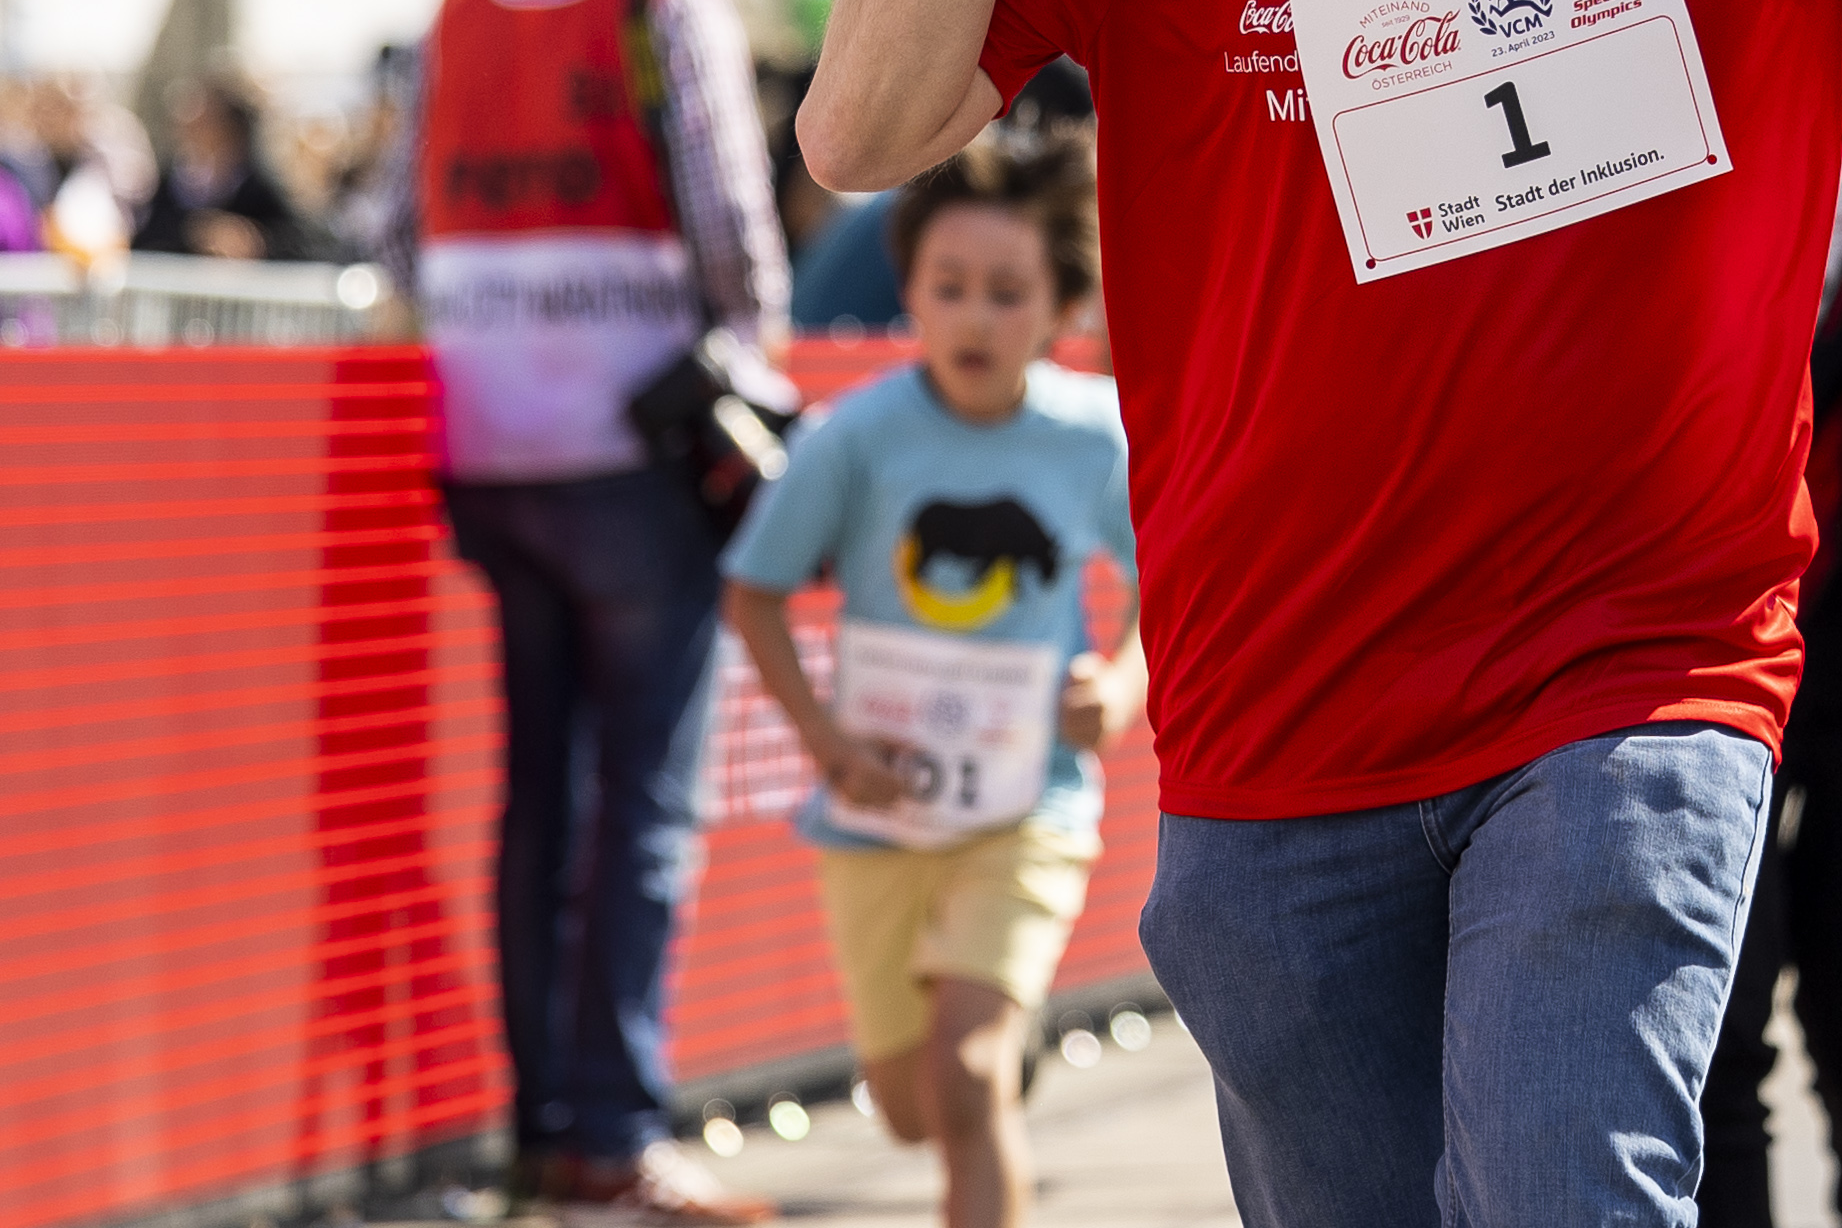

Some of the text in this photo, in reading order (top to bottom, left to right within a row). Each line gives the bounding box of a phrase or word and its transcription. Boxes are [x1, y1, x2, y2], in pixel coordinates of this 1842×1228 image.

[1359, 0, 1430, 29] MITEINAND
[1499, 13, 1544, 38] VCM
[1342, 9, 1461, 79] Coca-Cola
[1491, 30, 1556, 57] 23. April 2023
[1223, 50, 1299, 73] Laufend
[1371, 60, 1453, 91] ÖSTERREICH
[1266, 88, 1309, 122] Mi
[1483, 81, 1551, 169] 1
[1495, 148, 1666, 212] Stadt der Inklusion.
[1437, 195, 1481, 218] Stadt
[1442, 212, 1486, 233] Wien
